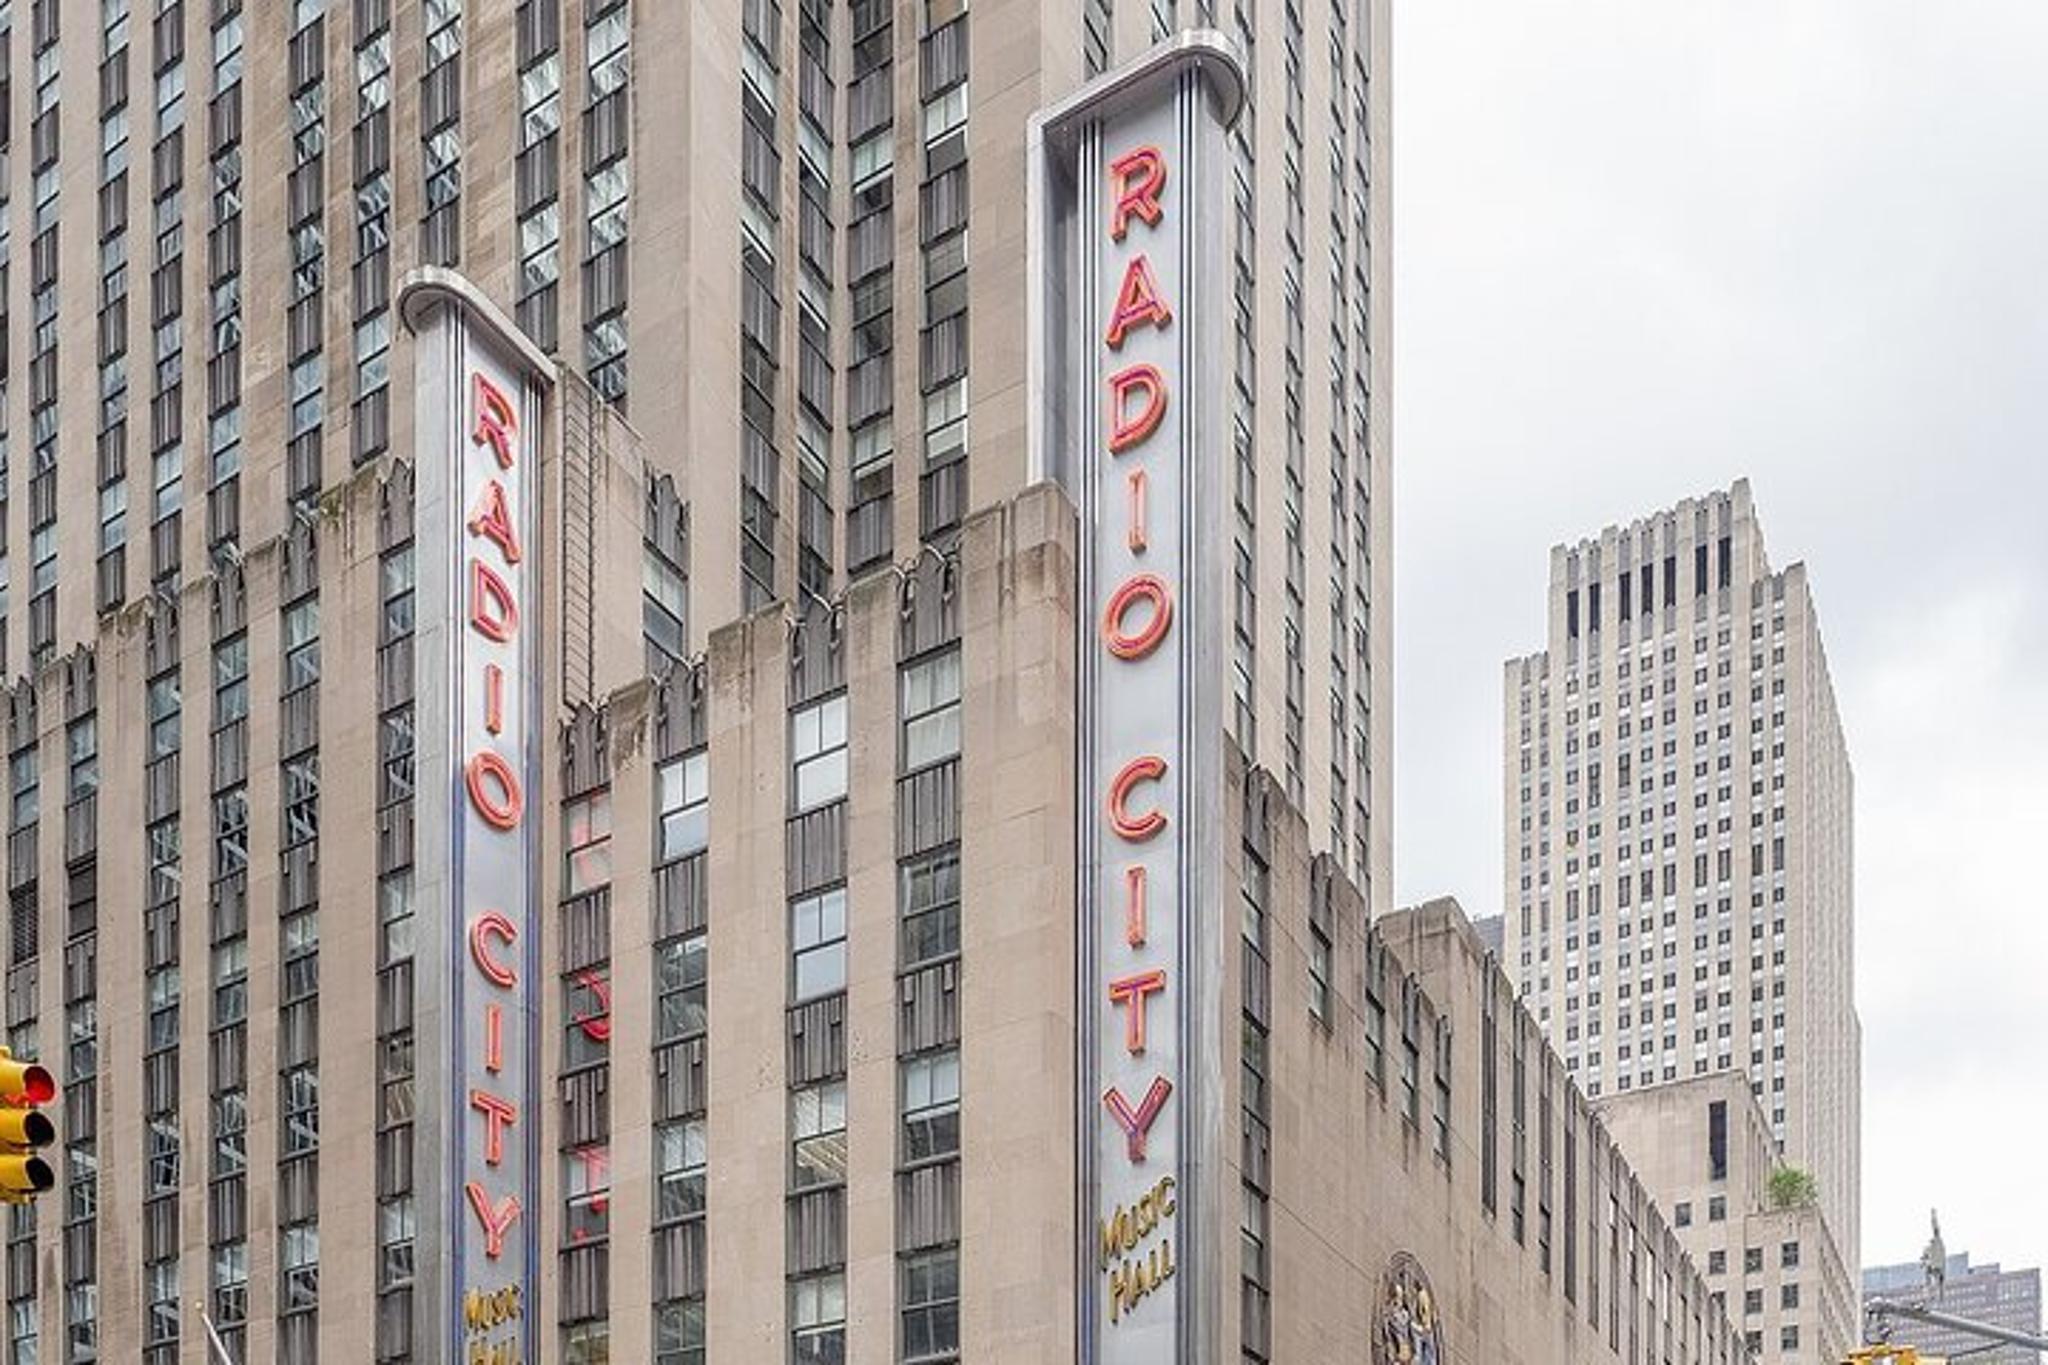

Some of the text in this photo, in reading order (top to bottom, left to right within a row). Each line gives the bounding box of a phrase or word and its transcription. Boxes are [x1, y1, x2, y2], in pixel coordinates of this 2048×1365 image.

[466, 371, 523, 1259] RADIO CITY
[1102, 145, 1172, 1162] RADIO CITY
[1109, 1238, 1176, 1326] HALL
